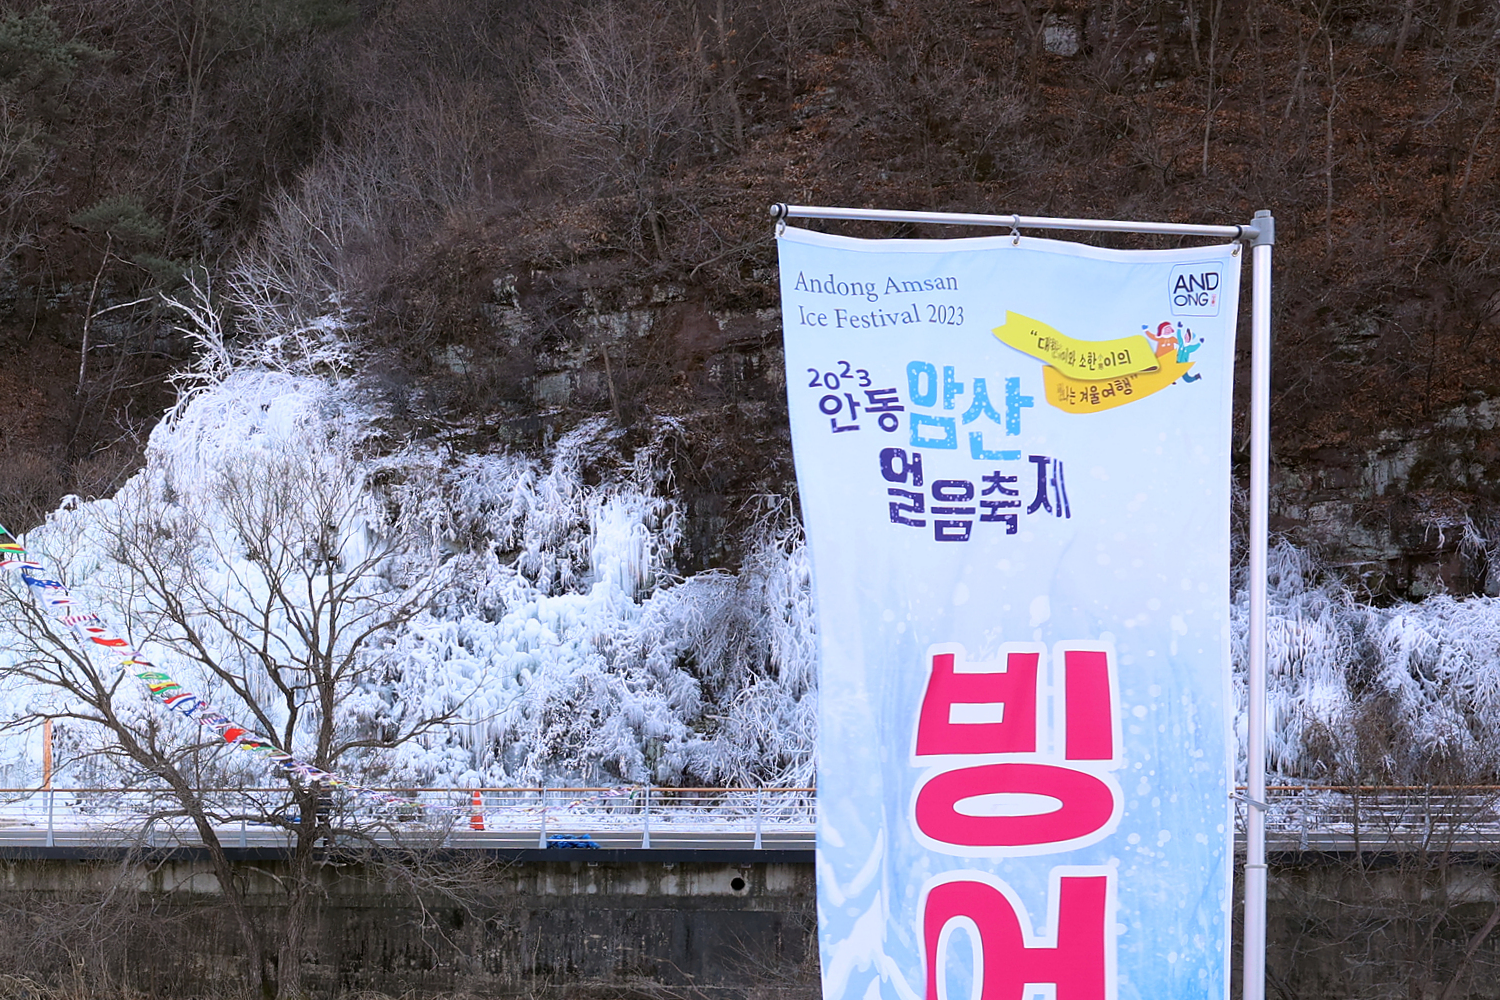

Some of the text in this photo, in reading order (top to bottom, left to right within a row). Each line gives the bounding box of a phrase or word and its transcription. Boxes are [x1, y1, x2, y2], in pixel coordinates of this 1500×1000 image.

[794, 271, 958, 303] Andong Amsan
[1173, 272, 1219, 294] AND
[1174, 292, 1209, 307] ONG
[798, 303, 965, 329] Ice Festival 2023
[806, 360, 873, 390] 2023
[819, 359, 1034, 461] 안동 암산
[879, 446, 1071, 542] 얼음축제
